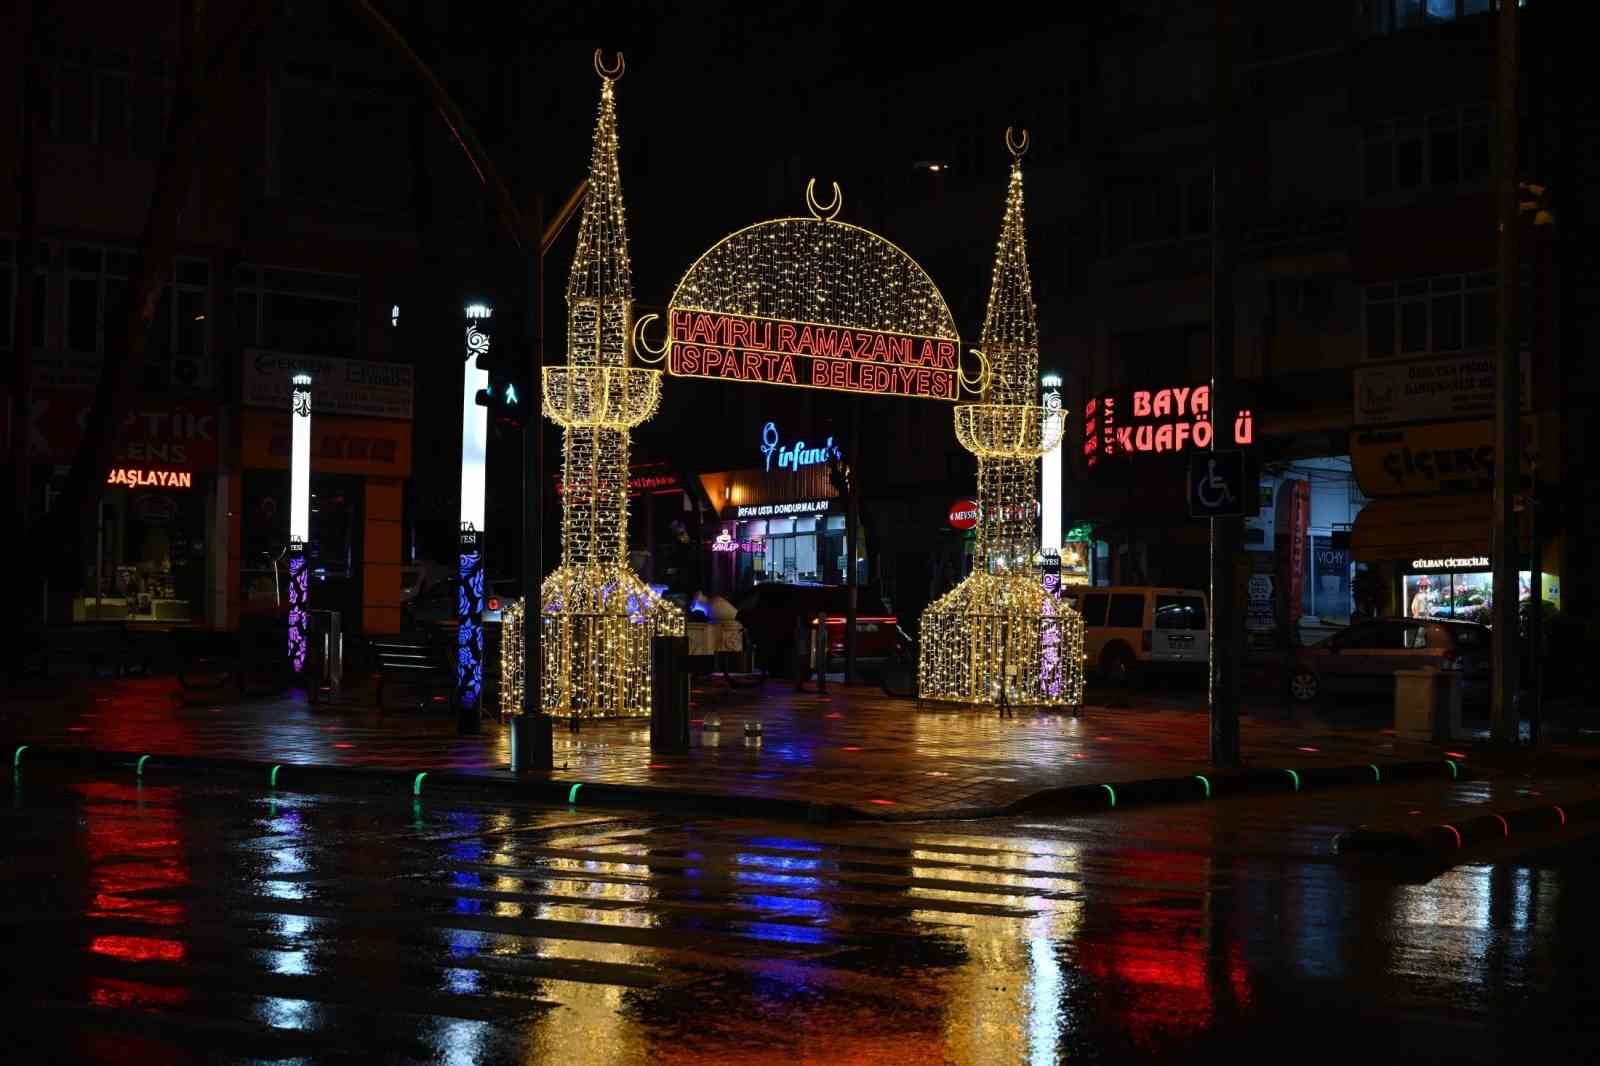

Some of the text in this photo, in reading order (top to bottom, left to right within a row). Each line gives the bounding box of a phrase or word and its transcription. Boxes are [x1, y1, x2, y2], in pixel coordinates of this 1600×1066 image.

[671, 310, 957, 369] HAYIRLI RAMAZANLAR
[672, 344, 797, 384] ISPARTA
[1133, 385, 1210, 418] BAYA
[1116, 410, 1253, 453] KUAFÖÜ
[758, 505, 773, 516] USTA
[774, 500, 829, 514] DONDURMALARI
